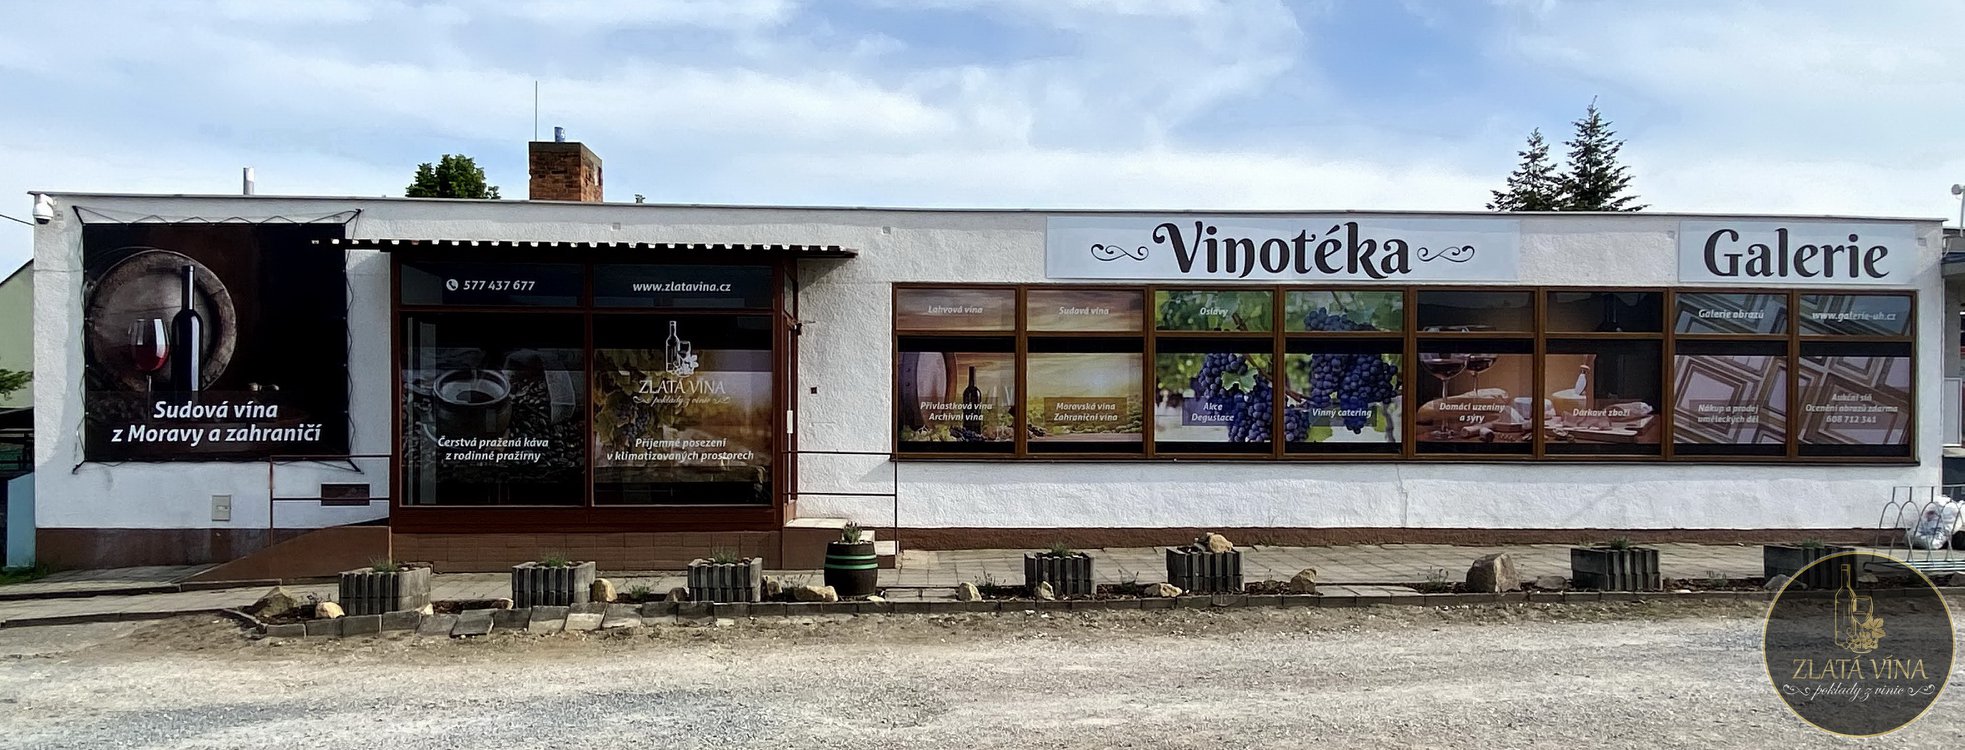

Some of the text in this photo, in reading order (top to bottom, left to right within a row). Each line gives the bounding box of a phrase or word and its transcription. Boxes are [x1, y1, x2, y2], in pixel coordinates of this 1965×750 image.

[1152, 220, 1412, 280] Vinotéka
[1704, 228, 1890, 278] Galerie
[464, 280, 535, 291] 577 437 677
[632, 281, 731, 292] www.zlatavina.cz
[928, 305, 984, 314] Lahvová vína
[1059, 306, 1110, 315] Sudová vína
[1200, 306, 1228, 318] Oslavy
[1698, 309, 1732, 319] Galerie
[1812, 312, 1896, 322] www.galerie-uh.cz
[639, 377, 686, 394] ZLATÁ
[154, 400, 278, 418] Sudová vína
[974, 402, 992, 410] vína
[1056, 402, 1116, 410] Moravská vína
[1203, 402, 1223, 411] Akce
[1439, 402, 1505, 413] Domácí uzeniny
[1698, 404, 1724, 414] Nákup
[1732, 404, 1759, 414] prodej
[929, 412, 984, 421] Archivní vína
[1053, 413, 1098, 421] Zahraniční
[1338, 408, 1372, 418] catering
[1573, 408, 1630, 417] Dárkové zboží
[1192, 413, 1234, 423] Degustace
[1466, 414, 1484, 423] sýry
[112, 423, 322, 446] z Moravy a zahraničí
[438, 435, 549, 449] Čerstvá pražená káva
[636, 438, 726, 449] Příjemné posezení
[454, 450, 494, 460] rodinné
[496, 450, 541, 463] pražírny
[615, 451, 699, 463] klimatizovaných
[700, 451, 754, 462] prostorech
